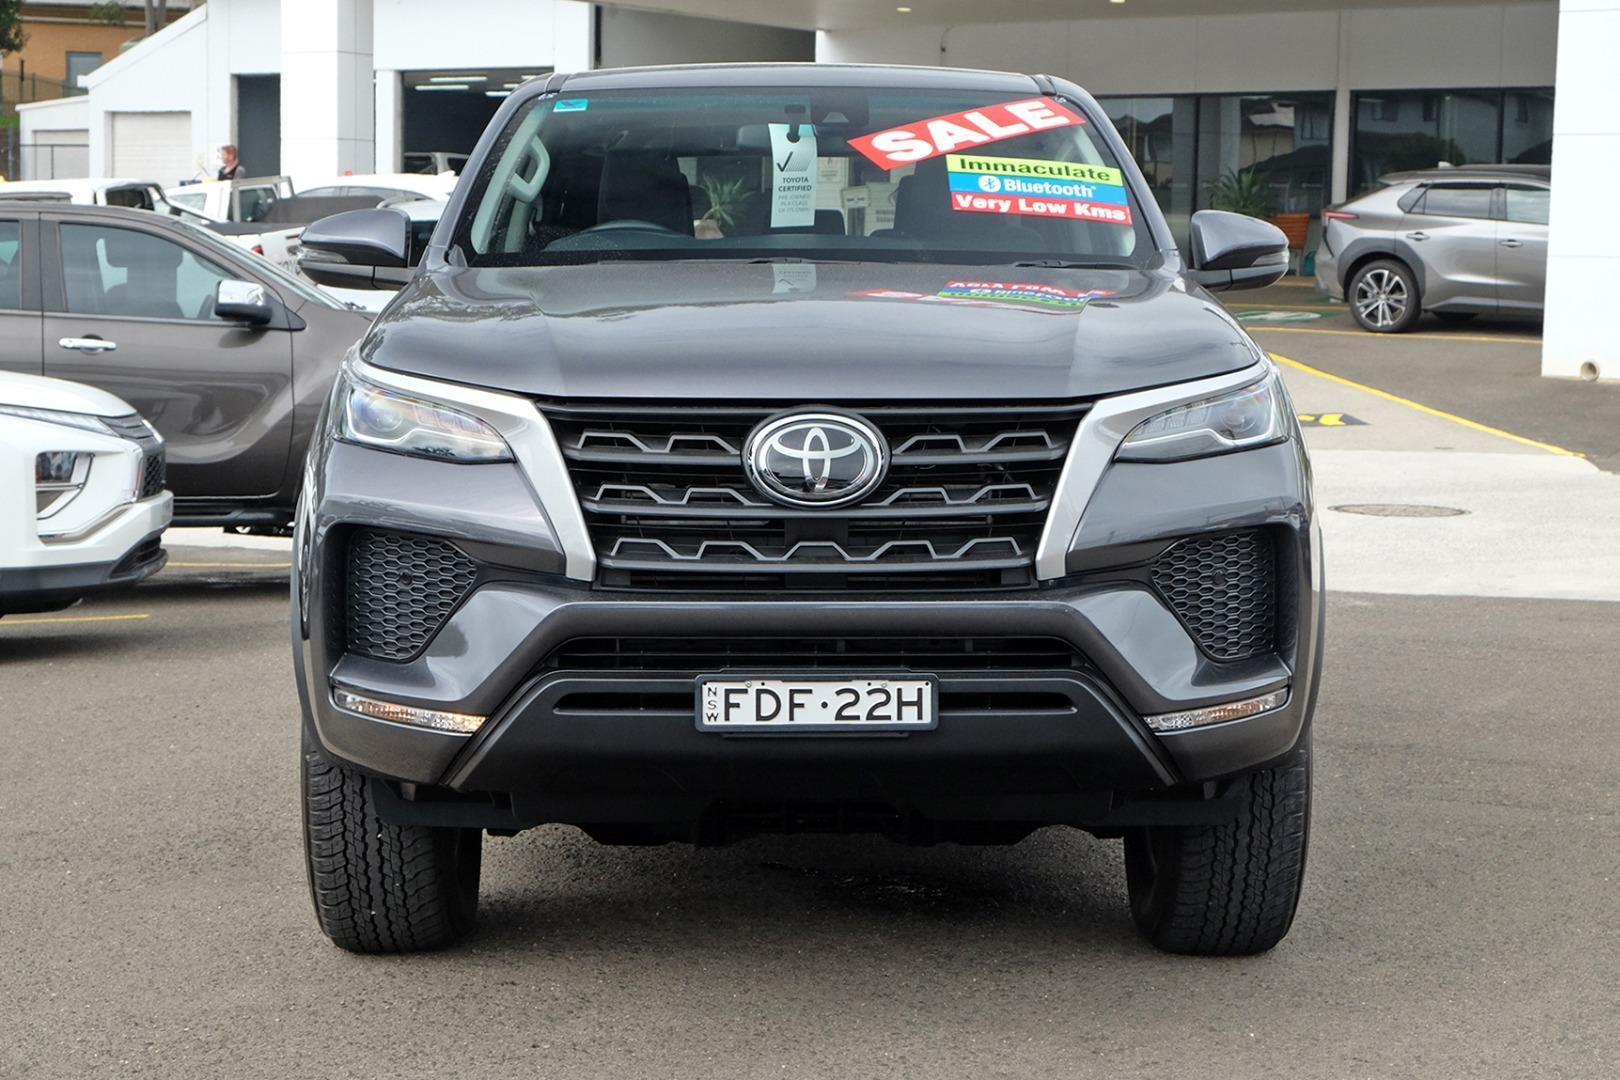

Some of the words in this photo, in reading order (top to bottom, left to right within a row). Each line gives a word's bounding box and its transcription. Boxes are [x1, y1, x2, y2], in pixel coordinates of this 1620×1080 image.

[871, 100, 1070, 162] SALE
[960, 158, 1111, 182] Immaculate
[1003, 178, 1093, 198] Bluetooth
[955, 193, 1012, 213] Very
[1018, 198, 1067, 214] Low
[1073, 202, 1126, 221] Kms
[705, 687, 719, 722] NSW
